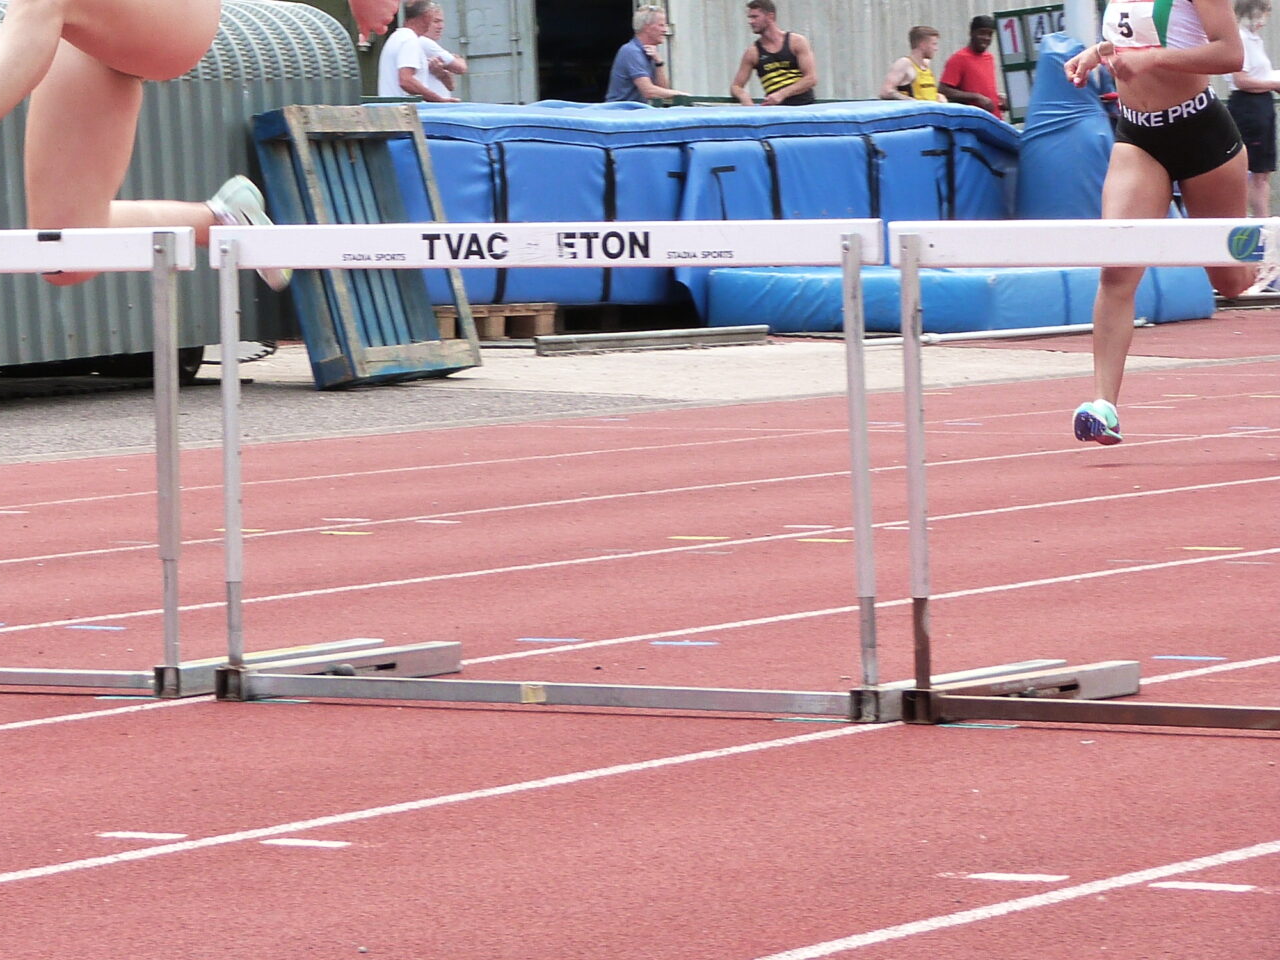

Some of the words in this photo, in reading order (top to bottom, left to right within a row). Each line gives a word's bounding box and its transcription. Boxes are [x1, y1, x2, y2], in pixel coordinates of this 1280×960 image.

[1003, 18, 1019, 53] 1
[1118, 12, 1133, 38] 5
[1122, 105, 1165, 127] NIKE
[1168, 92, 1208, 124] PRO
[342, 253, 372, 262] STADIA
[375, 253, 407, 262] SPORTS
[421, 232, 509, 261] TVAC
[556, 230, 651, 260] ETON
[666, 250, 698, 260] STADIA
[701, 250, 735, 260] SPORTS
